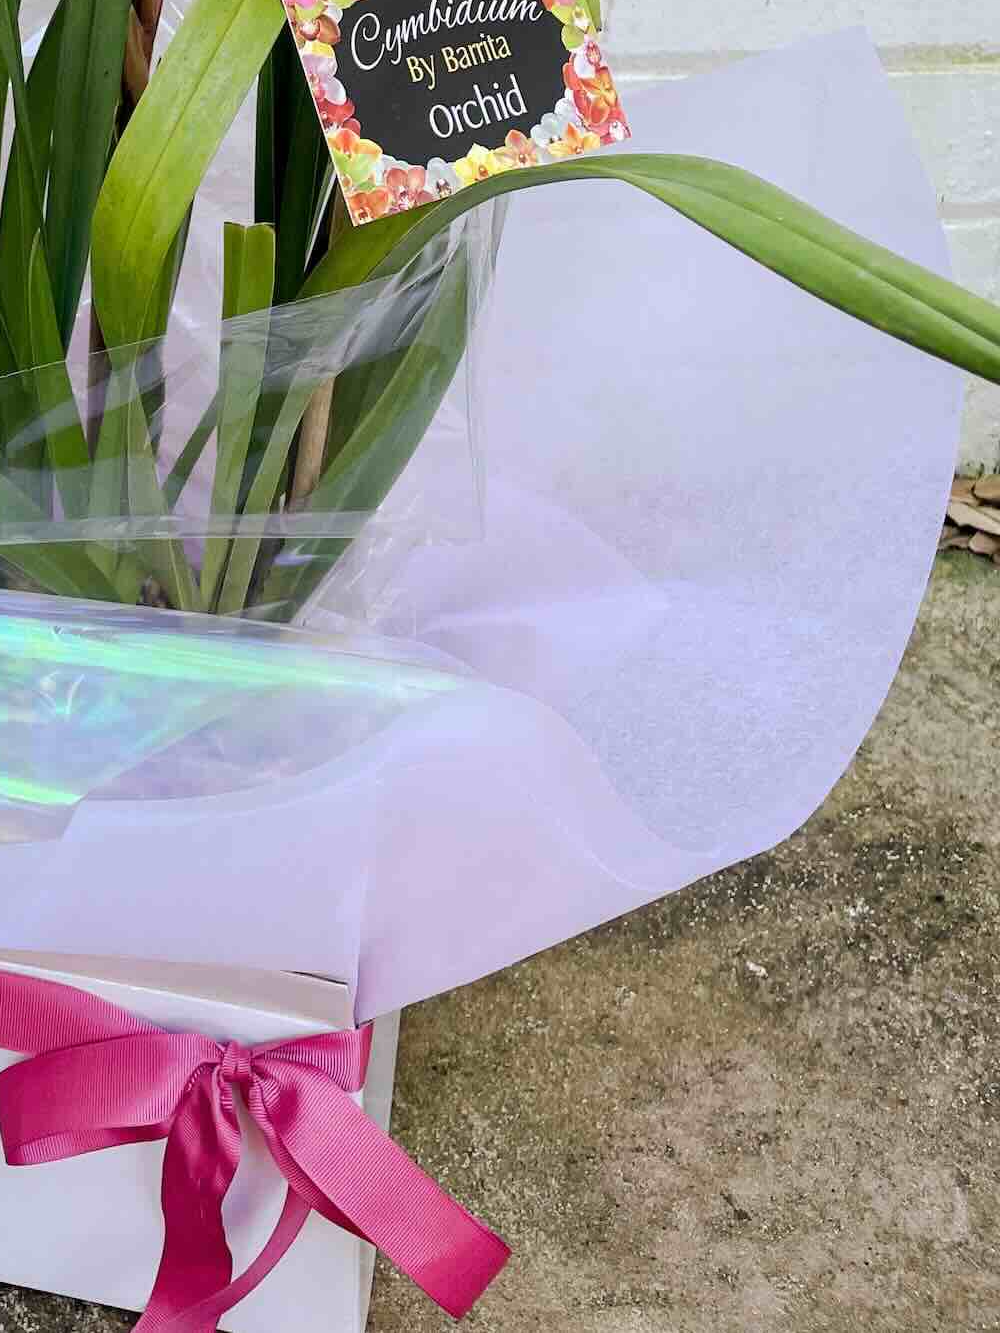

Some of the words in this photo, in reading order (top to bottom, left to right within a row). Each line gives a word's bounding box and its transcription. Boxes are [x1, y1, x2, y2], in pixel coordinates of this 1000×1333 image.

[406, 55, 436, 90] By
[441, 33, 512, 73] Barrita
[429, 74, 528, 138] Orchid
